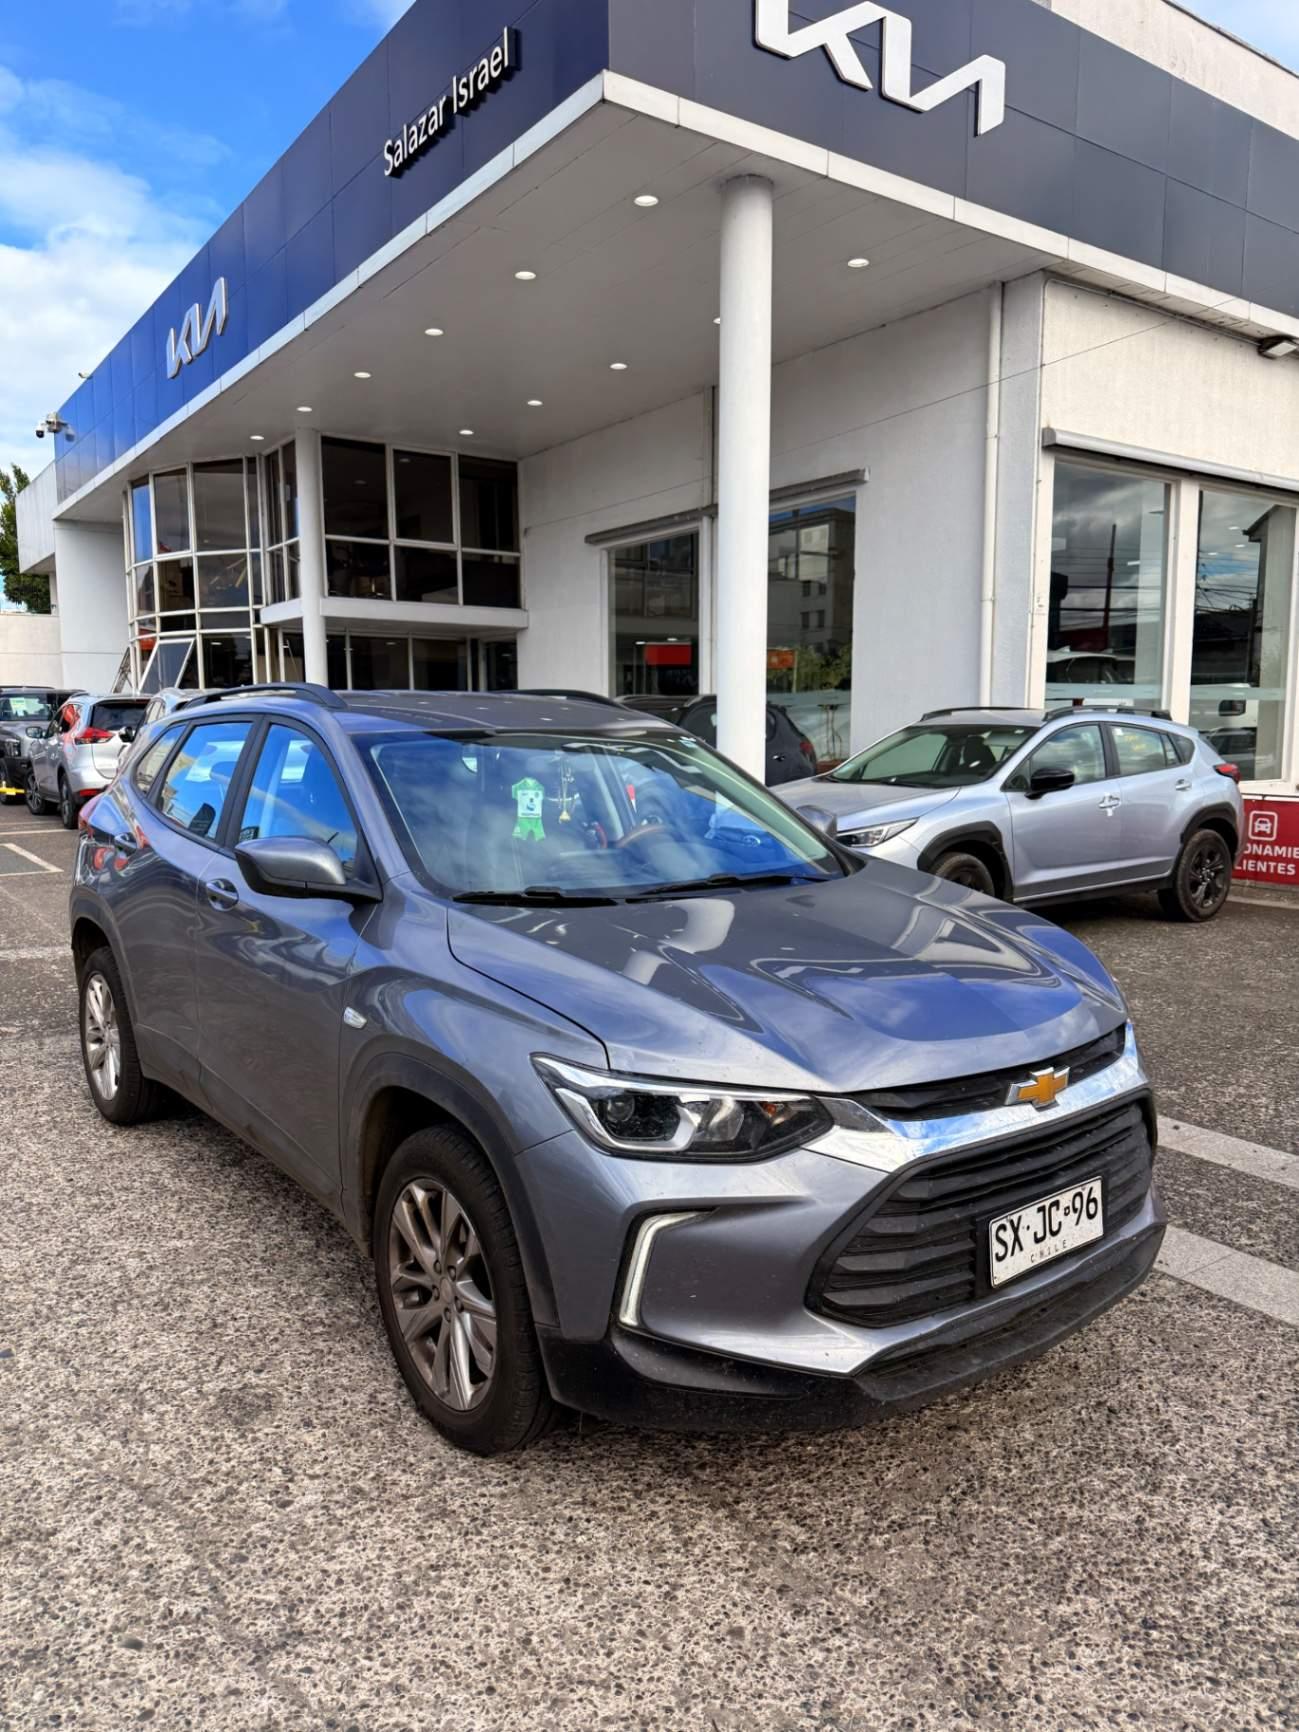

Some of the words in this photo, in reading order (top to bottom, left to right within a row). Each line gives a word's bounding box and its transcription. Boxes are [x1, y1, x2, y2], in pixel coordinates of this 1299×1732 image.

[384, 94, 446, 176] Salazar
[453, 26, 509, 114] Israel
[756, 0, 1006, 135] KIA
[166, 277, 226, 379] KIA
